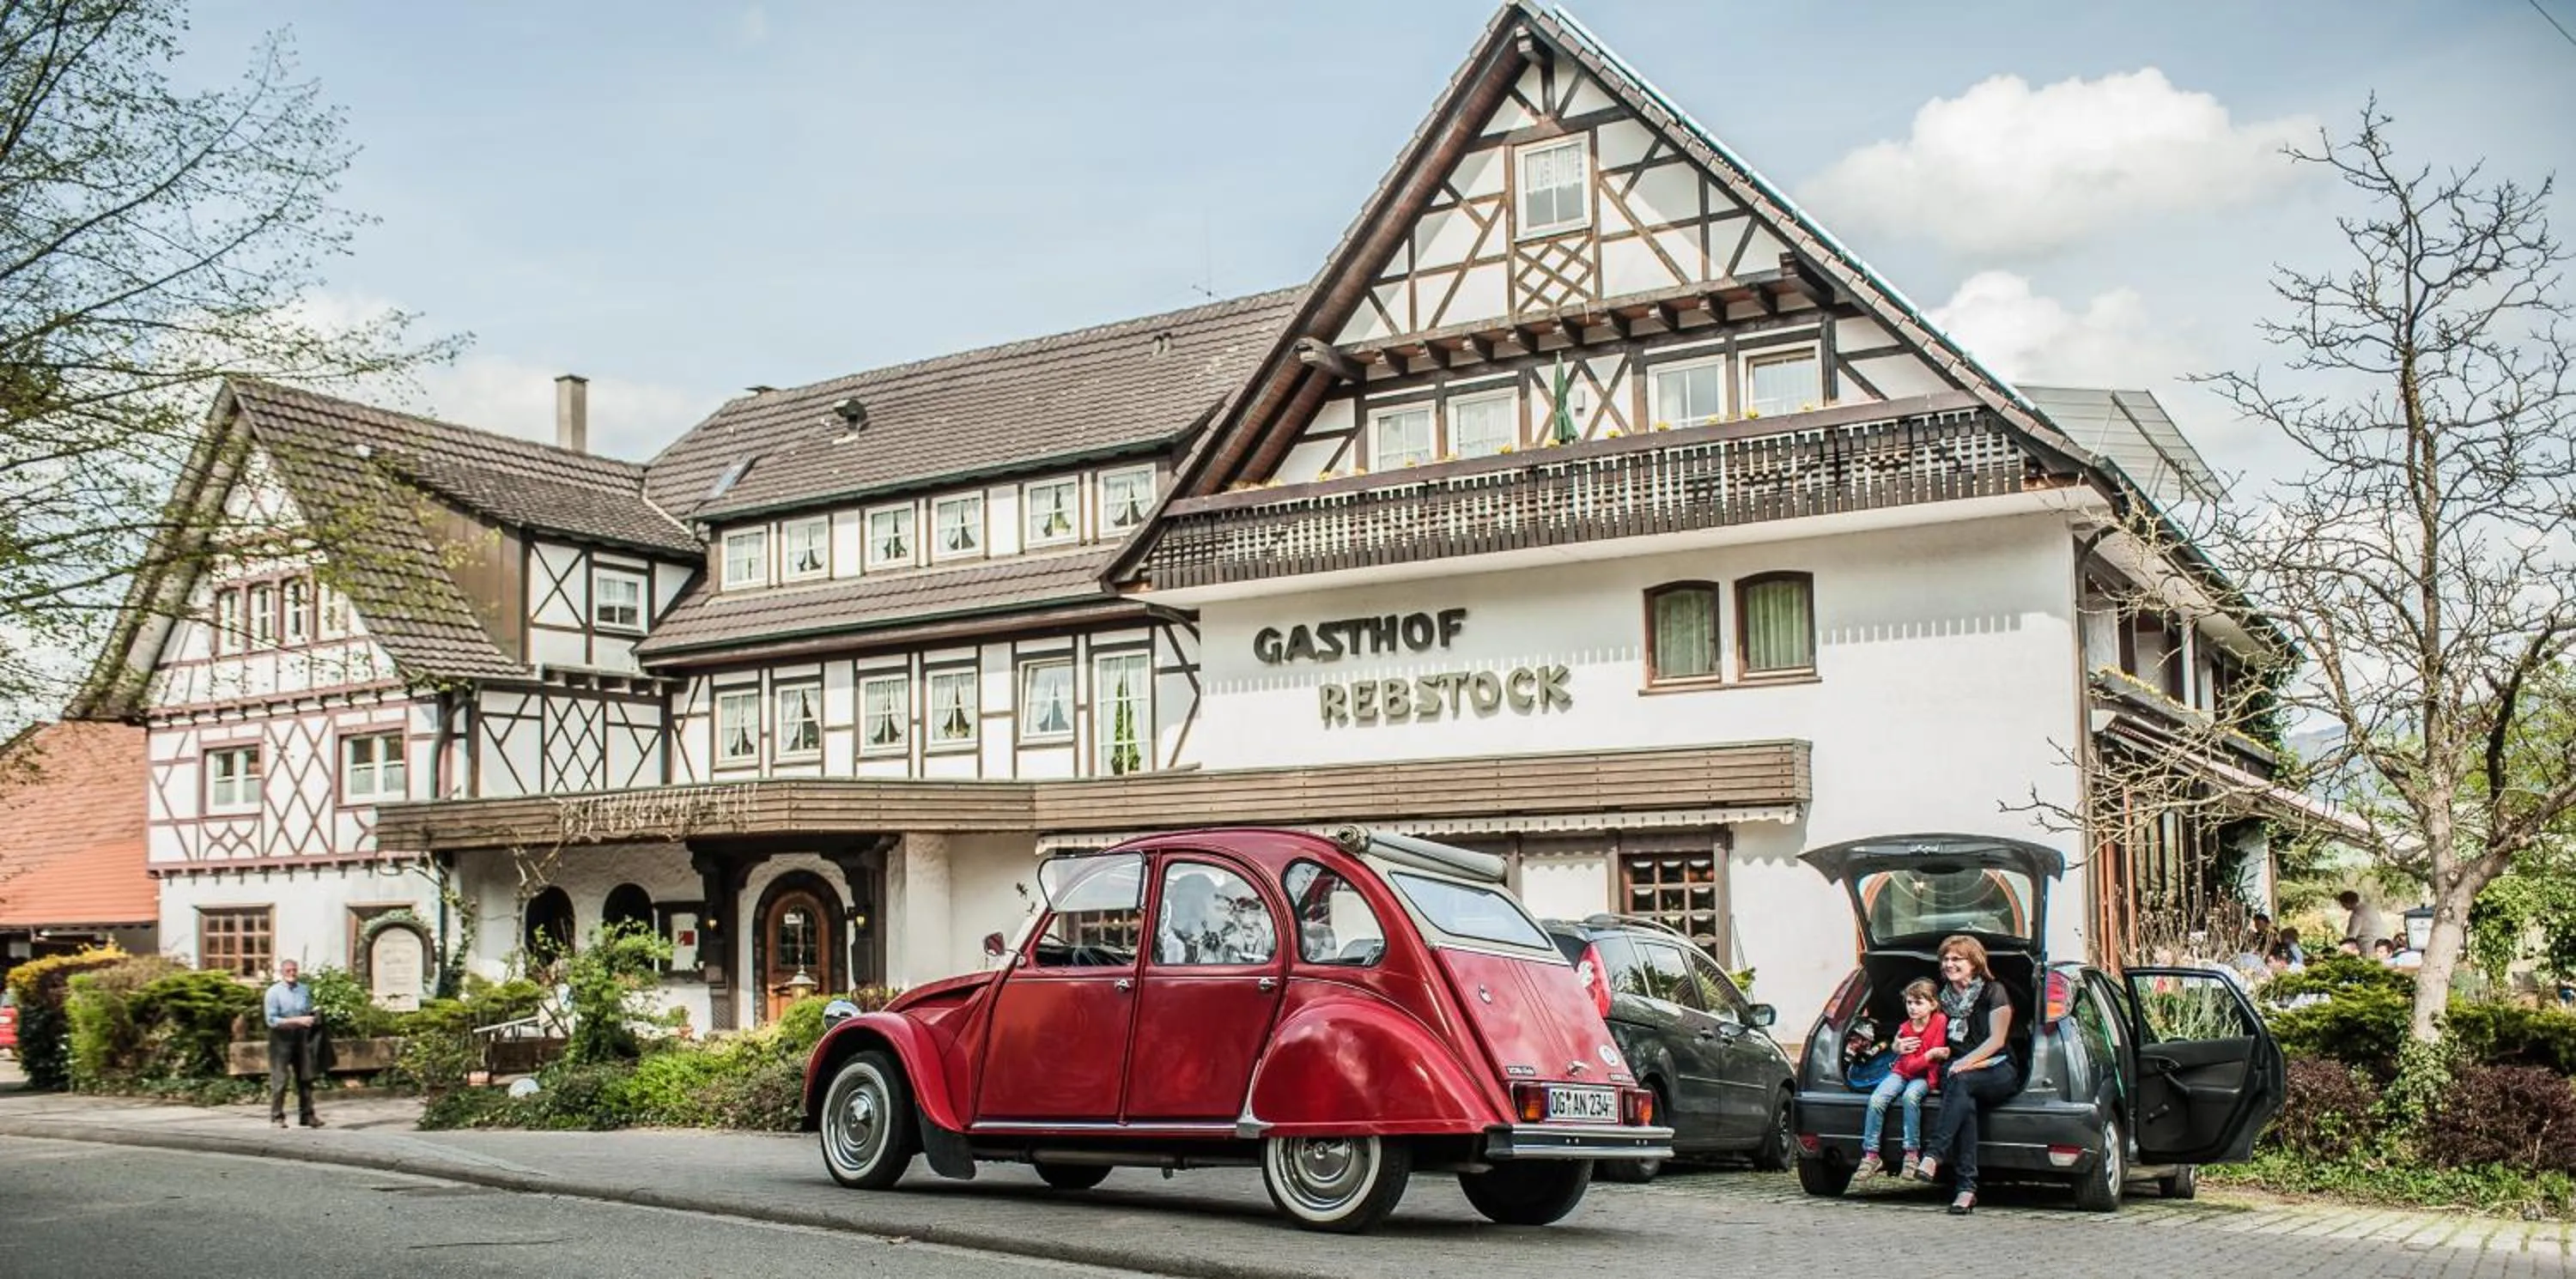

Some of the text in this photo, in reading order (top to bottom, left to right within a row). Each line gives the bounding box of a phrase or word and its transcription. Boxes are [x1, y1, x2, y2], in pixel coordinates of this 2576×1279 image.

[1253, 607, 1467, 665] GASTHOF
[1318, 664, 1573, 729] REBSTOCK
[1551, 1091, 1565, 1114] OG
[1573, 1092, 1588, 1116] AN
[1589, 1093, 1608, 1117] 234
